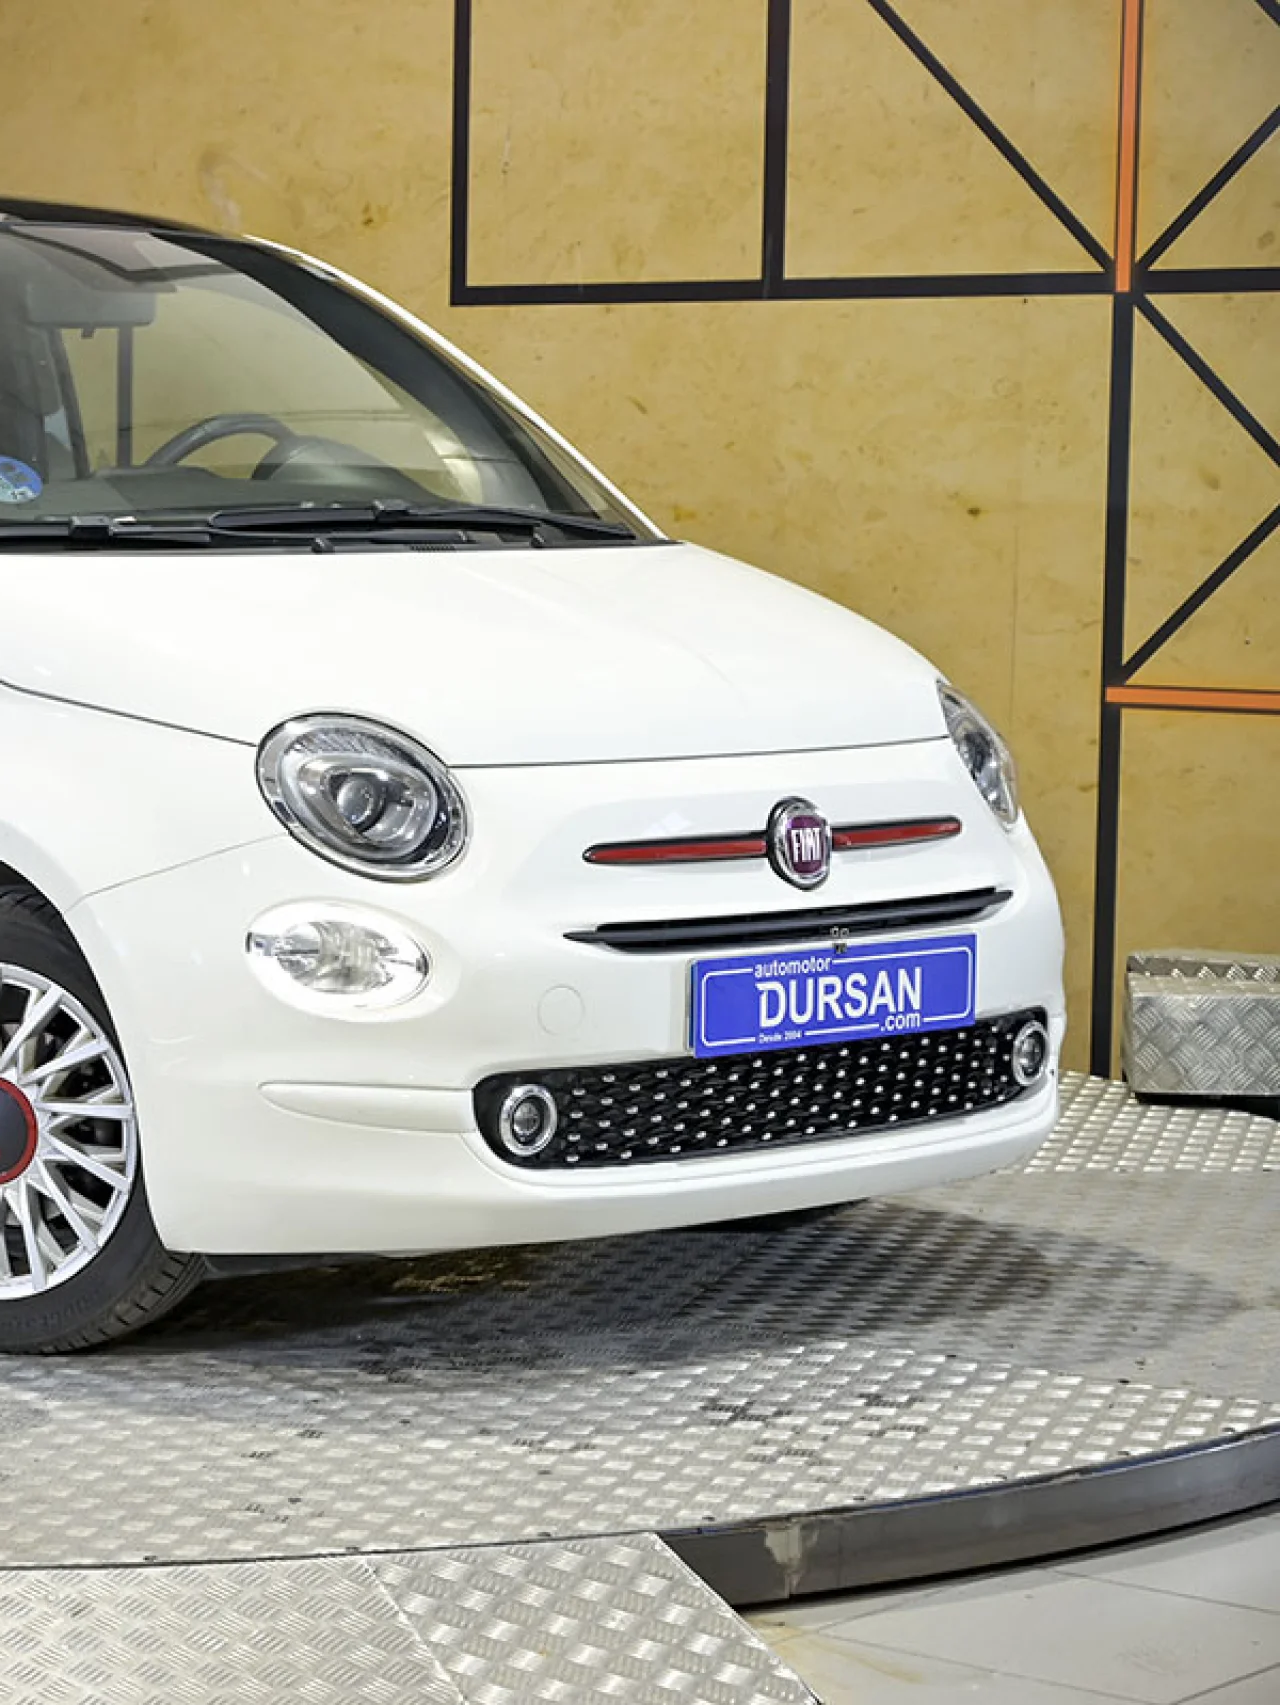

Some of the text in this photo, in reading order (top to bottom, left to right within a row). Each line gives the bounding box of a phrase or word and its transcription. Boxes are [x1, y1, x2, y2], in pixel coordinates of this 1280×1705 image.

[790, 827, 821, 863] FIAT
[754, 956, 832, 979] automotor
[755, 966, 922, 1028] DURSAN
[880, 1012, 920, 1032] .com
